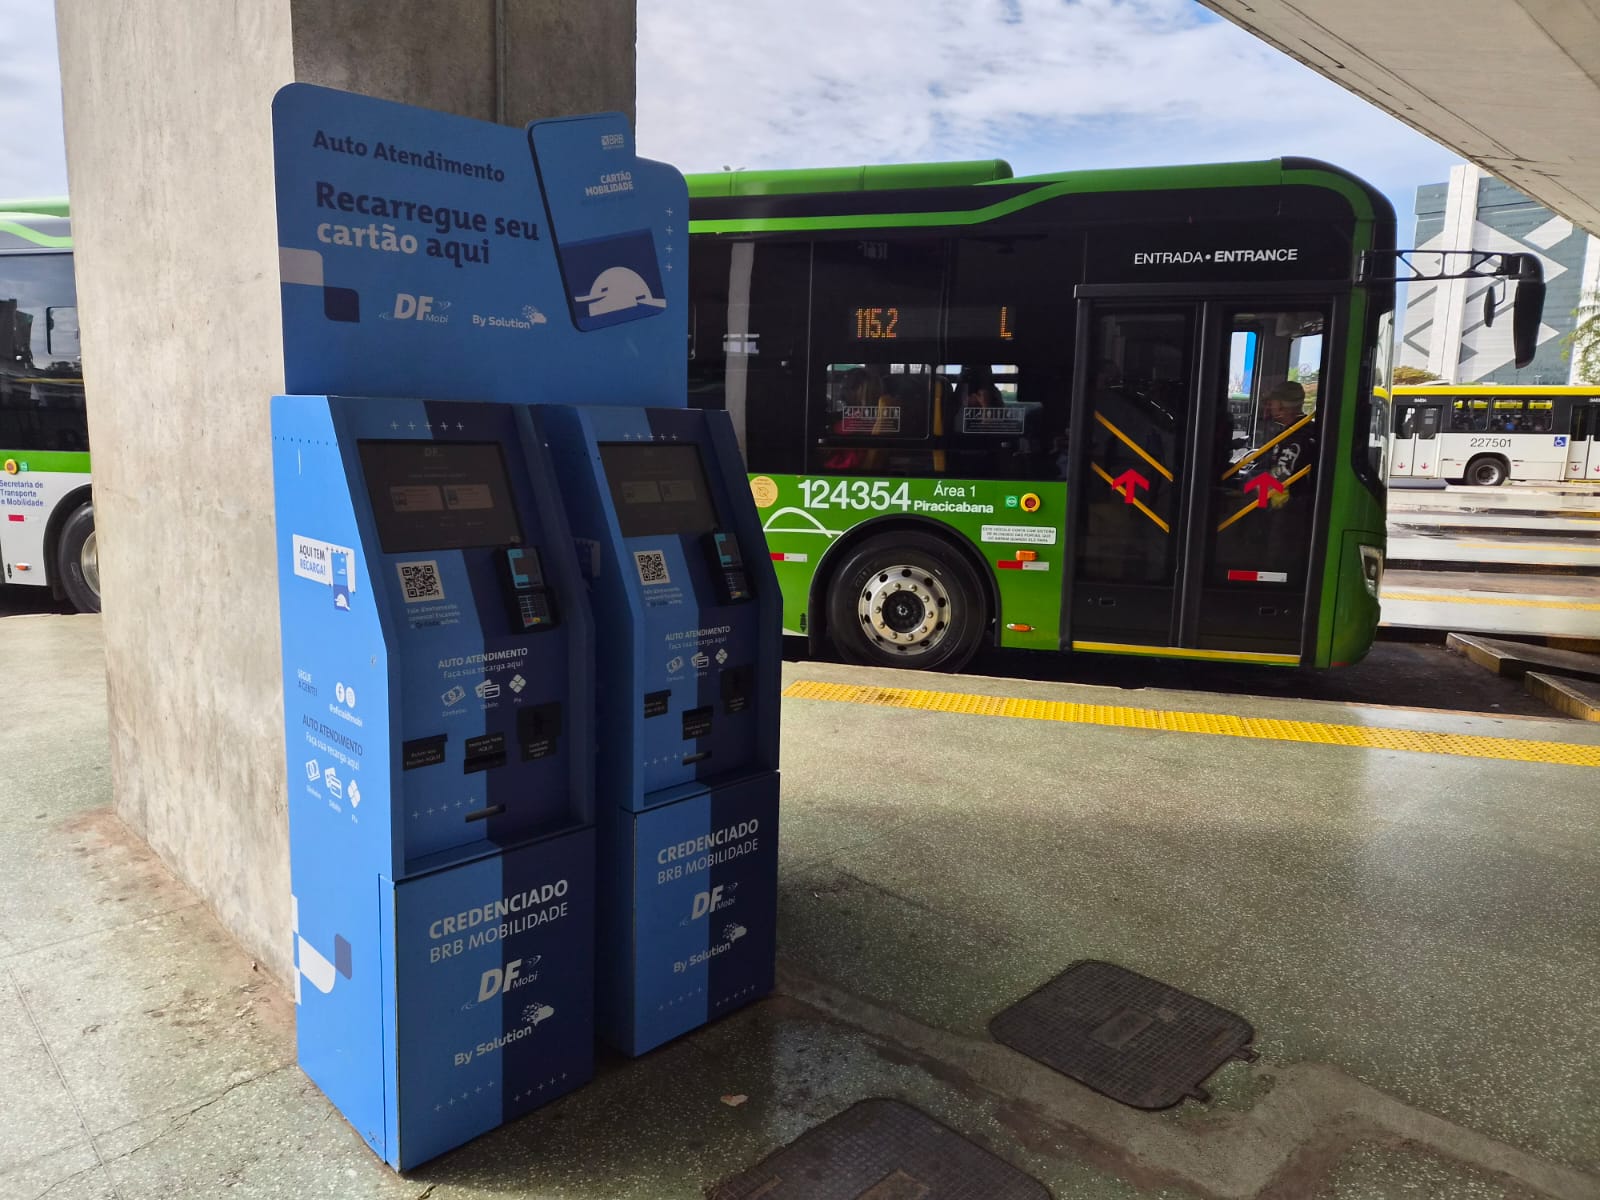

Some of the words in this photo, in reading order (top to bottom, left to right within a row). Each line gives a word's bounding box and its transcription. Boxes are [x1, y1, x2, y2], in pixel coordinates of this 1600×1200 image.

[312, 129, 368, 158] Auto
[373, 140, 505, 183] Atendimento
[585, 180, 634, 197] MOBILIDADE
[600, 170, 632, 184] CARTÃO
[315, 181, 487, 235] Recarregue
[494, 213, 540, 241] seu
[316, 221, 418, 255] cartão
[426, 235, 490, 268] aqui
[1134, 250, 1203, 265] ENTRADA
[1214, 248, 1298, 263] ENTRANCE
[393, 293, 434, 321] DF
[425, 312, 449, 325] Mobi
[471, 314, 486, 329] By
[488, 314, 531, 330] Solution
[856, 307, 898, 339] 115.2
[1001, 306, 1012, 338] L
[1470, 437, 1512, 448] 227501
[0, 480, 34, 488] Secretaria
[34, 481, 44, 489] de
[0, 488, 37, 498] Transporte
[798, 479, 912, 511] 124354
[933, 480, 966, 497] Área
[969, 485, 976, 497] 1
[6, 498, 44, 507] Mobilidade
[914, 500, 994, 514] Piracicabana
[299, 543, 313, 559] AQUI
[313, 547, 326, 561] TEM
[665, 632, 684, 641] AUTO
[685, 625, 731, 639] ATENDIMENTO
[438, 657, 464, 669] AUTO
[465, 647, 528, 664] ATENDIMENTO
[302, 713, 319, 731] AUTO
[319, 723, 363, 756] ATENDIMENTO
[657, 818, 759, 865] CREDENCIADO
[657, 865, 682, 885] BRB
[685, 838, 759, 874] MOBILIDADE
[428, 879, 569, 940] CREDENCIADO
[691, 885, 724, 920] DF
[429, 939, 464, 964] BRB
[468, 902, 569, 950] MOBILIDADE
[673, 959, 687, 973] By
[689, 942, 731, 967] Solution
[477, 959, 522, 1002] DF
[512, 970, 539, 989] Mobi
[453, 1050, 473, 1066] By
[476, 1025, 532, 1056] Solution
